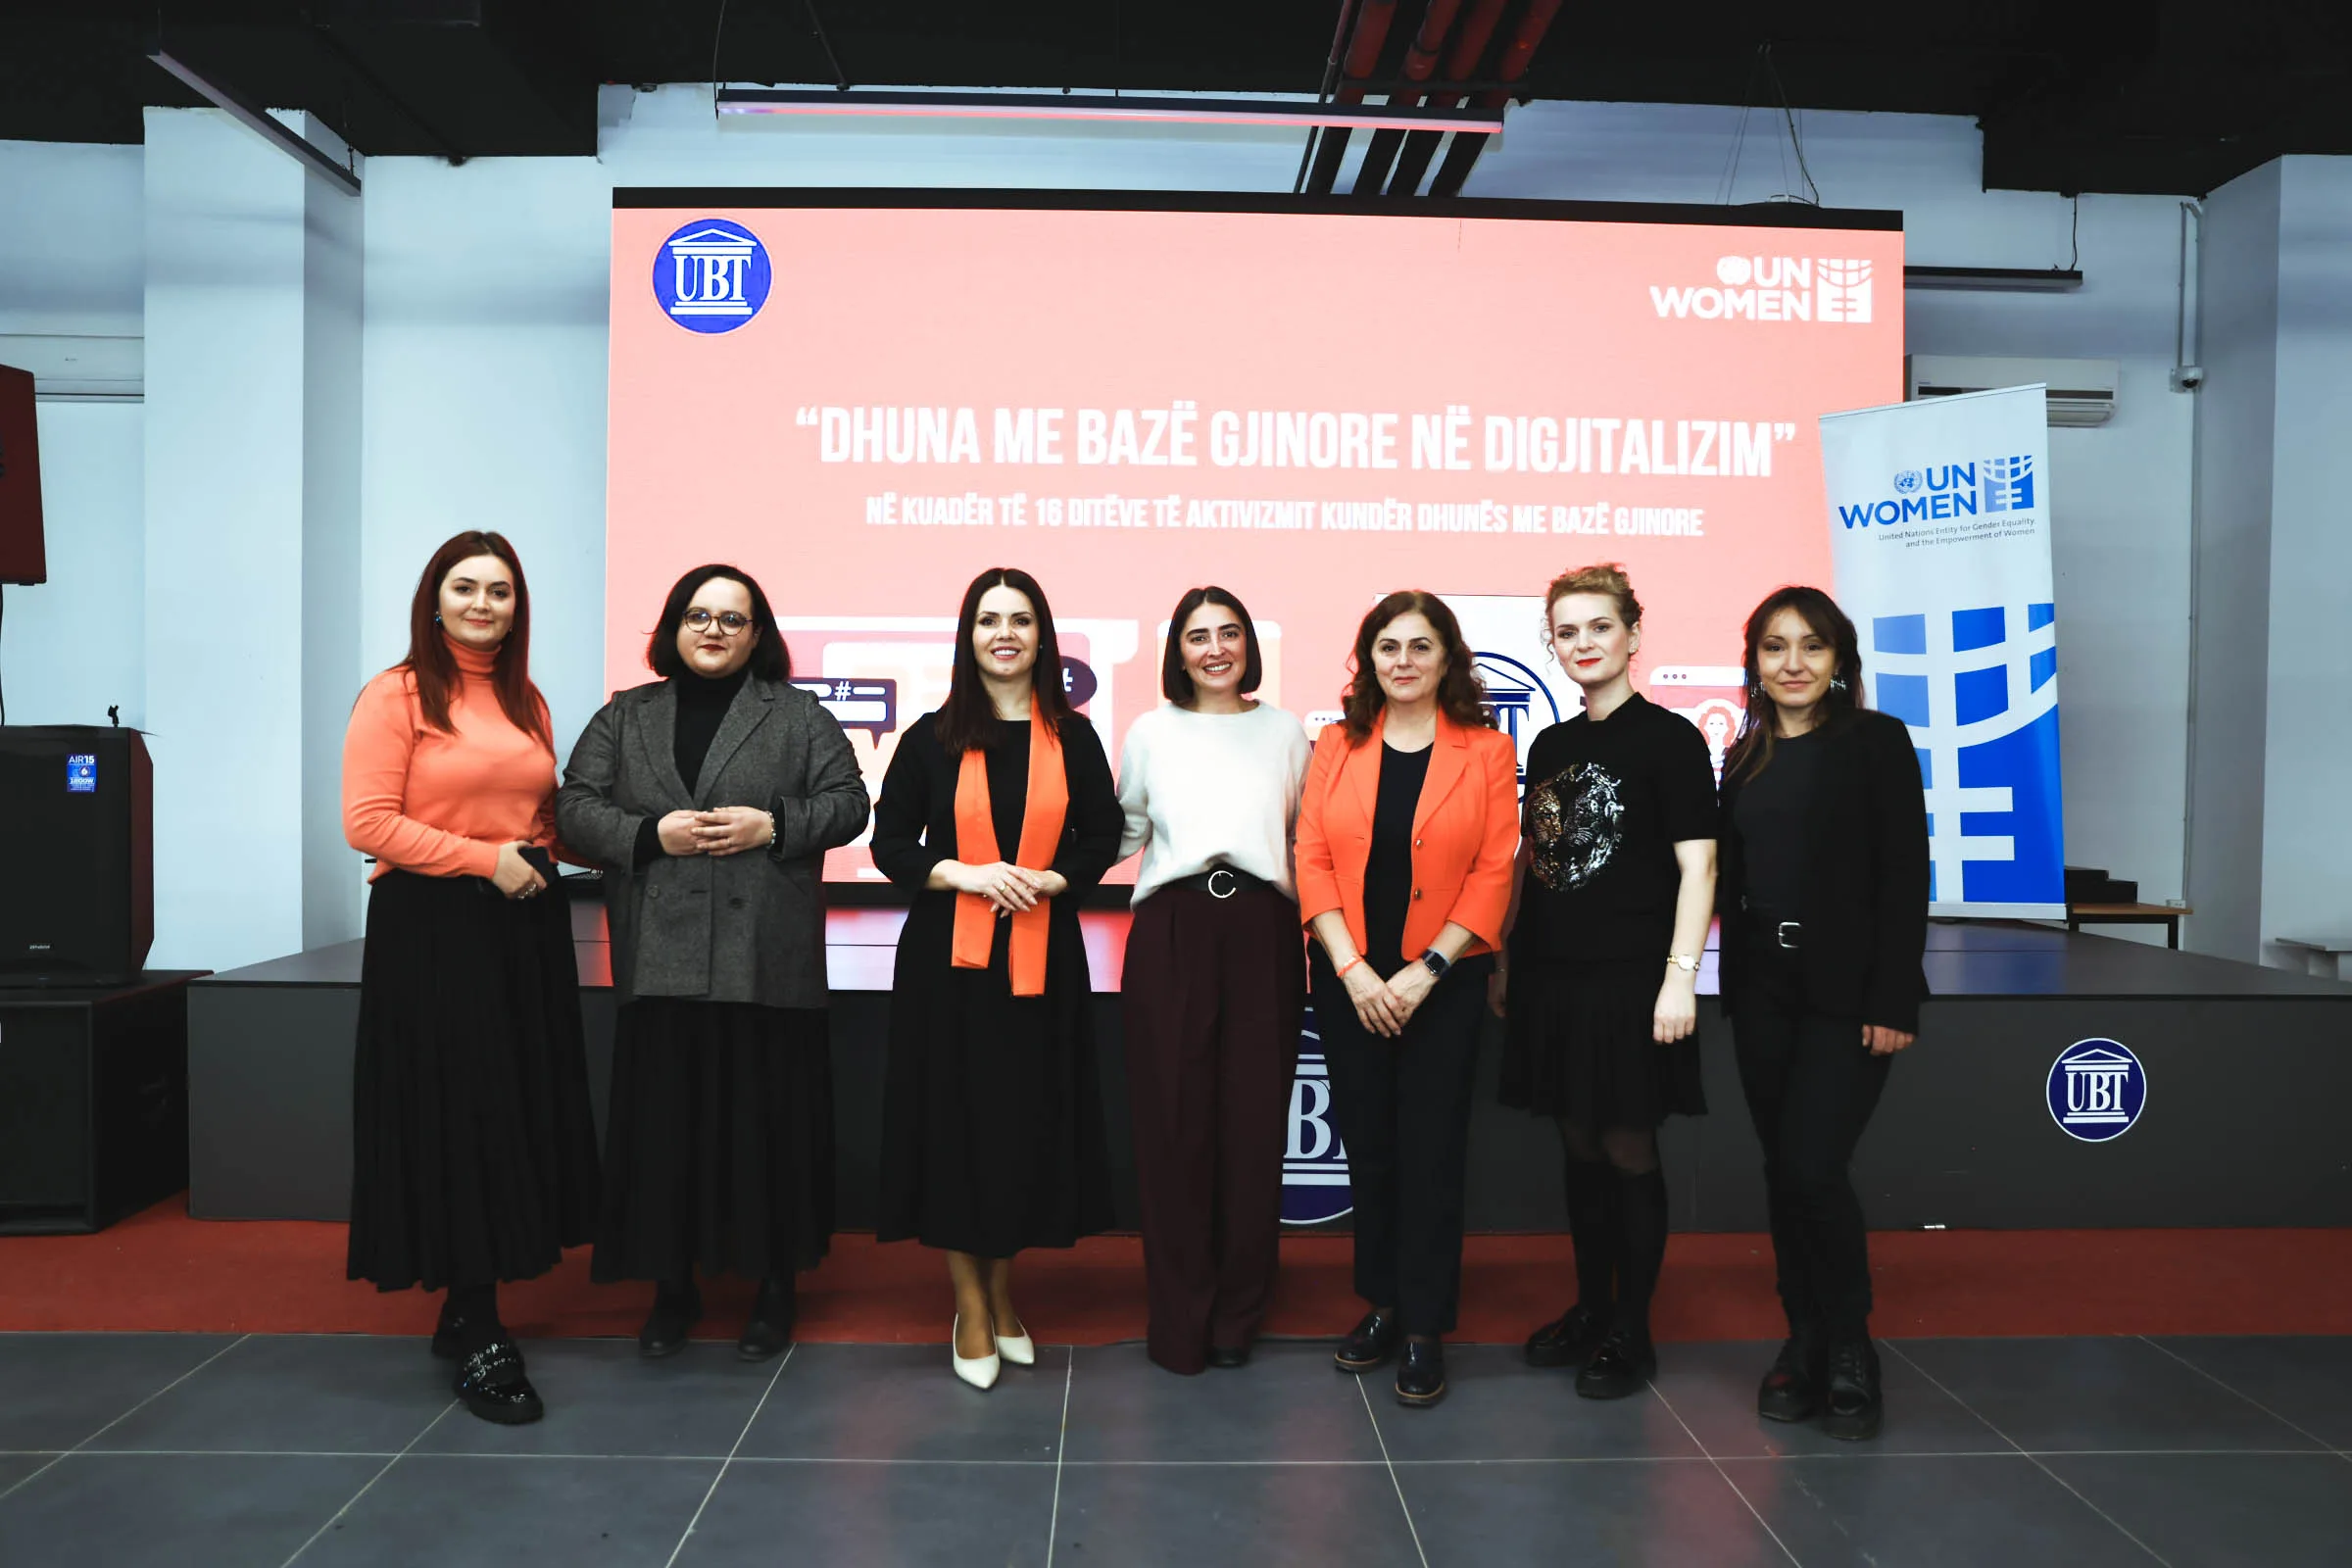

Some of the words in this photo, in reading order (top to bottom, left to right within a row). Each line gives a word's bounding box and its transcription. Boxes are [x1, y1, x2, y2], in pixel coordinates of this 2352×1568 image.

[673, 255, 752, 302] UBT
[1752, 257, 1811, 288] UN
[1648, 285, 1811, 321] WOMEN
[796, 406, 981, 465] “DHUNA
[993, 407, 1064, 465] ME
[1077, 400, 1199, 466] BAZË
[1209, 410, 1398, 469] GJINORE
[1411, 405, 1472, 470] NË
[1926, 462, 1977, 491] UN
[865, 491, 898, 526] NË
[902, 491, 995, 526] KUADËR
[998, 492, 1028, 527] TË
[1035, 497, 1063, 527] 16
[1067, 493, 1149, 527] DITËVE
[1152, 494, 1182, 527] TË
[1185, 498, 1315, 530] AKTIVIZMIT
[1321, 498, 1413, 531] KUNDËR
[1417, 499, 1508, 533] DHUNËS
[1512, 504, 1546, 533] ME
[1551, 501, 1610, 535] BAZË
[1613, 507, 1704, 536] GJINORE
[1838, 490, 1978, 530] WOMEN
[1879, 532, 1904, 541] United
[1905, 529, 1935, 539] Nations
[1936, 526, 1958, 536] Entity
[1973, 521, 2000, 531] Gender
[1905, 539, 1920, 548] and
[1922, 538, 1935, 547] the
[1936, 532, 1992, 545] Empowerment
[2003, 527, 2035, 538] Women
[2065, 1071, 2129, 1111] UBT
